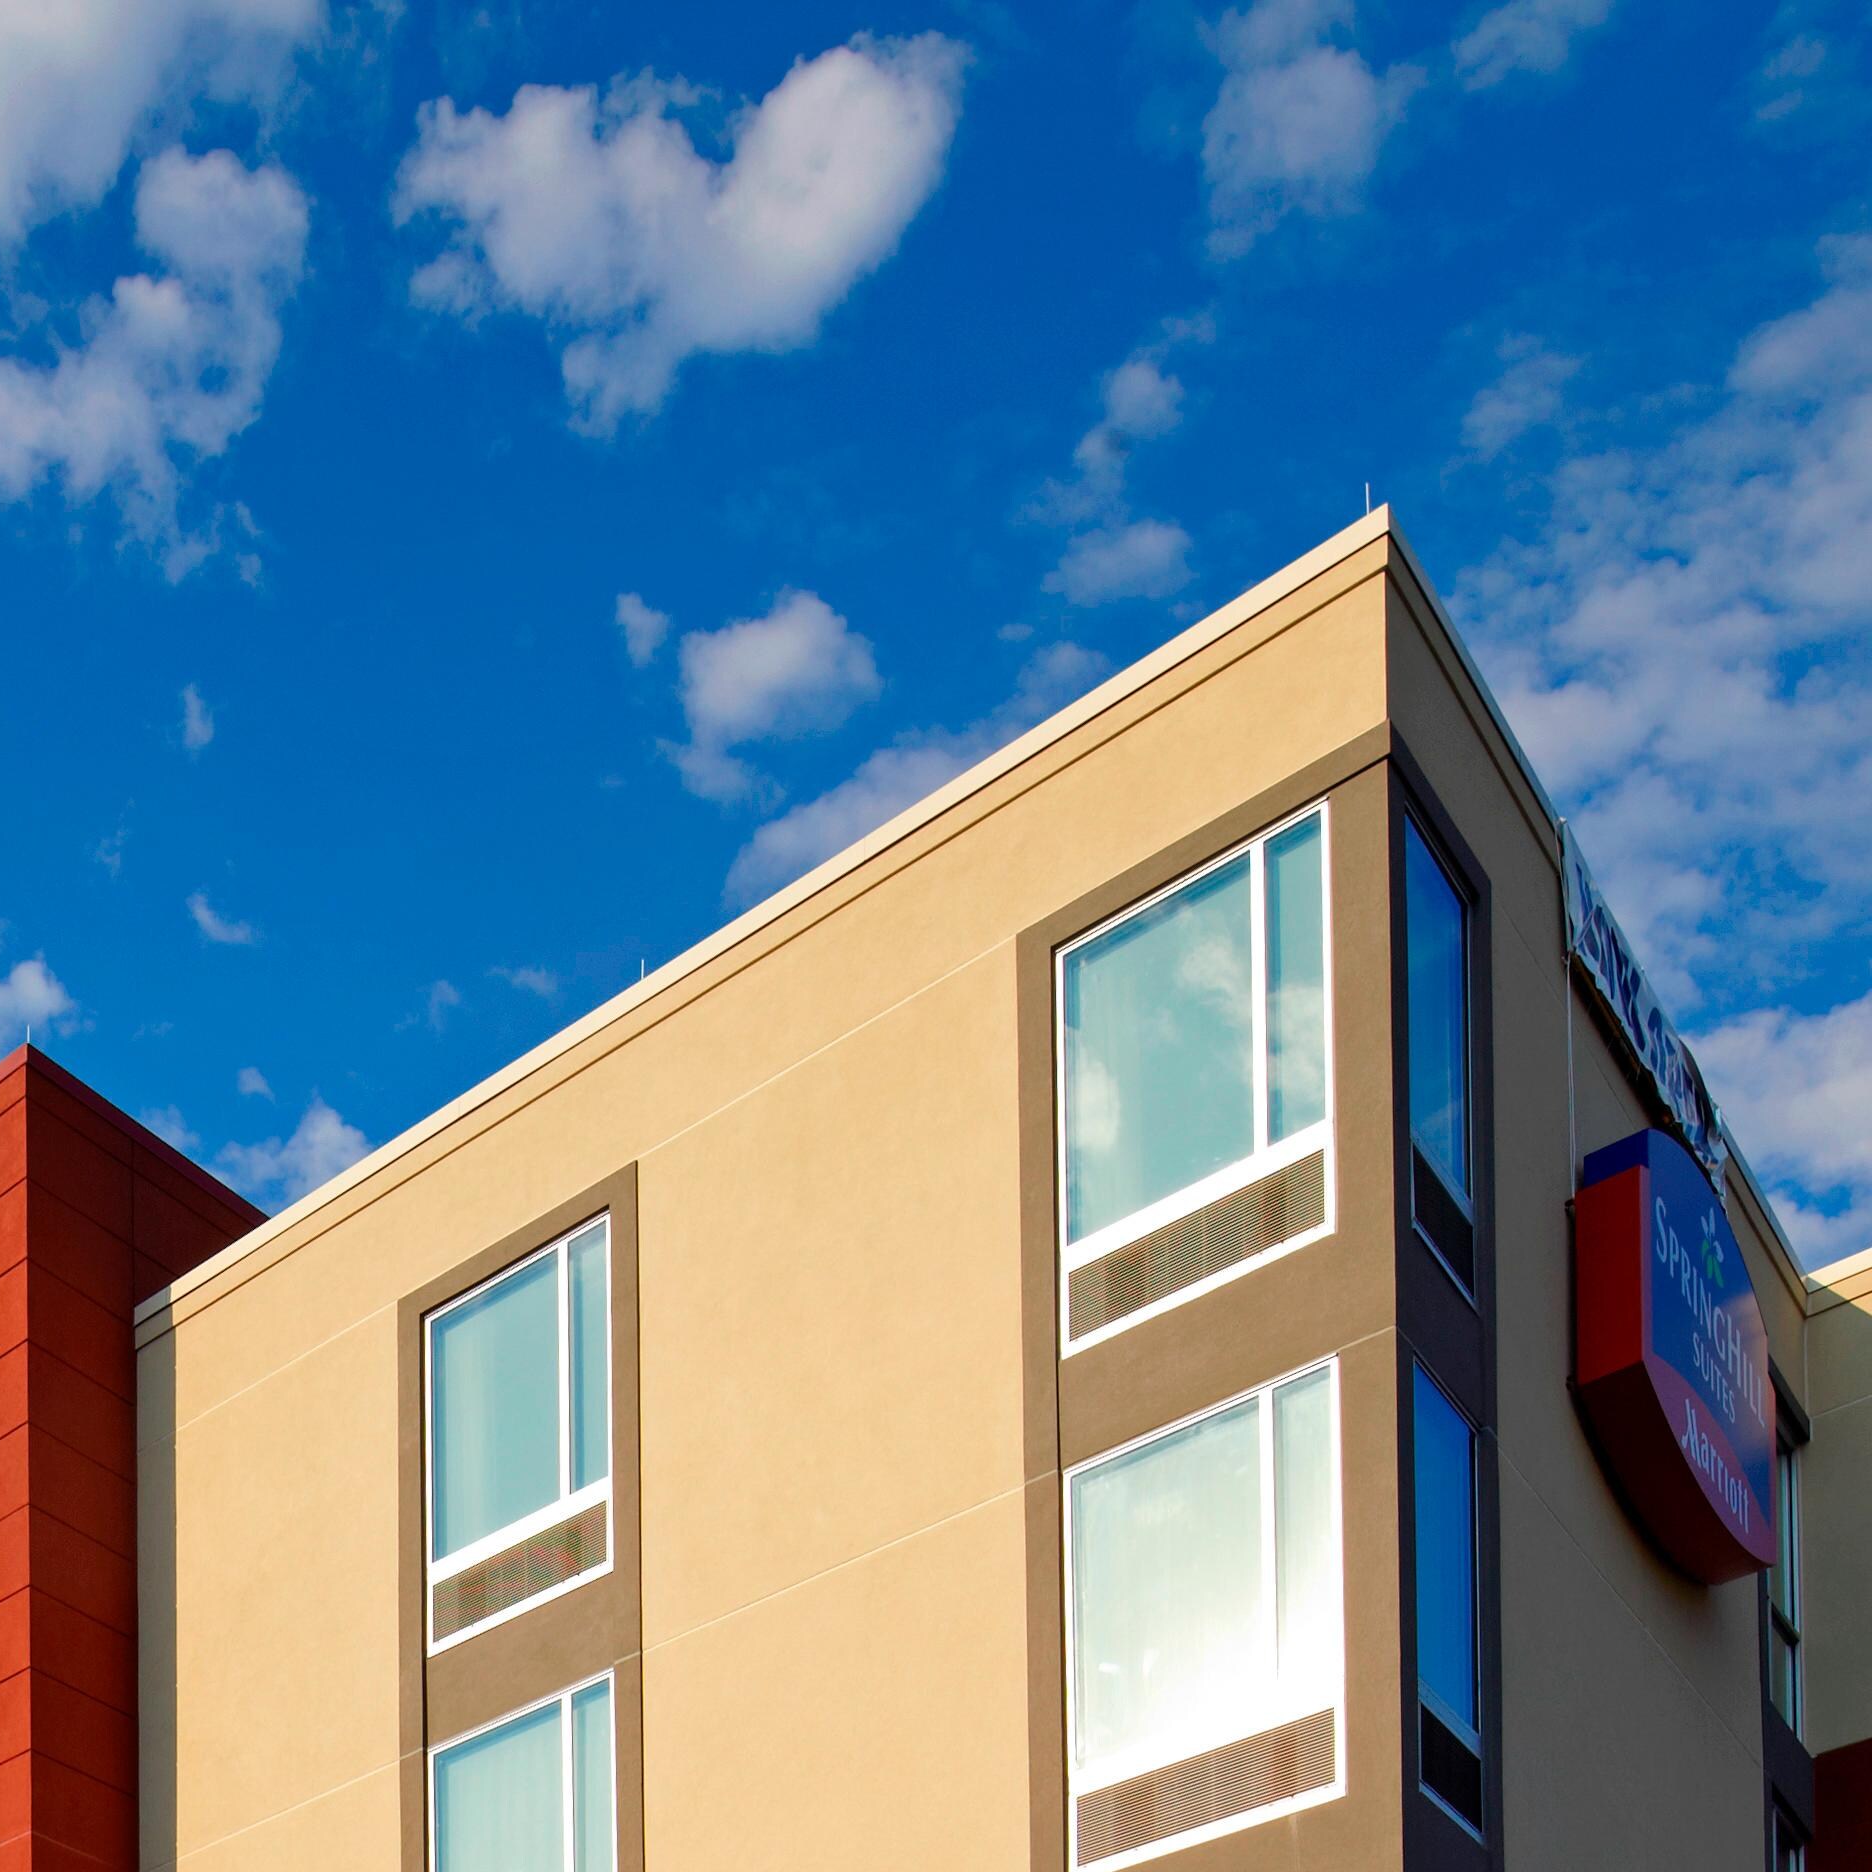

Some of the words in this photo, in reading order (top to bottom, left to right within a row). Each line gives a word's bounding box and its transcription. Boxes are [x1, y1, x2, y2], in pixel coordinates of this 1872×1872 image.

[1655, 1195, 1766, 1429] SPRINGHILL
[1692, 1334, 1737, 1425] SUITES
[1681, 1398, 1749, 1535] Marriott
